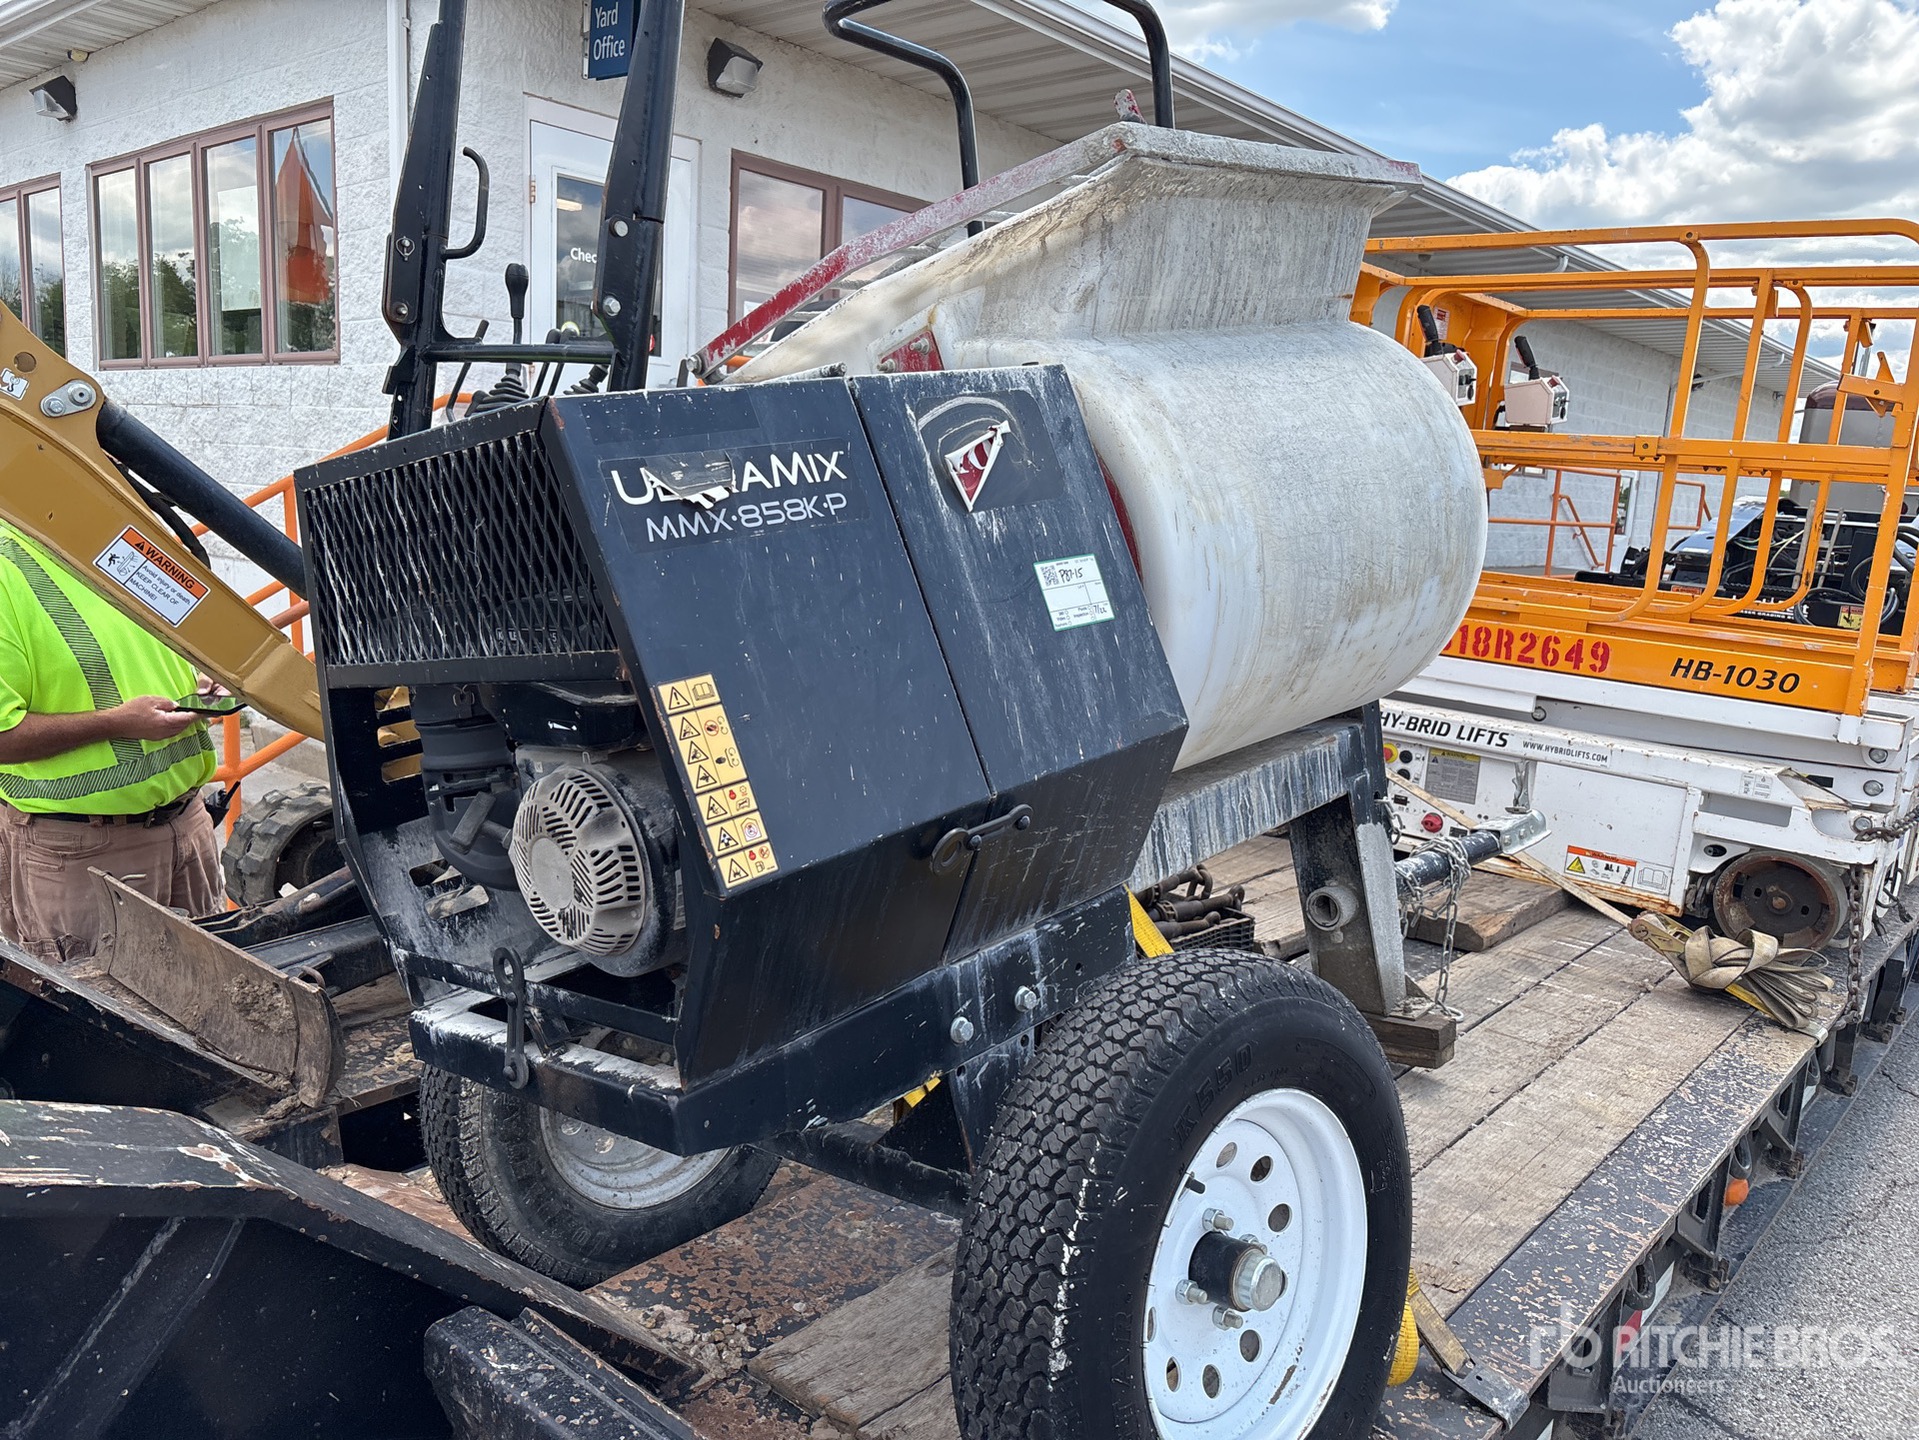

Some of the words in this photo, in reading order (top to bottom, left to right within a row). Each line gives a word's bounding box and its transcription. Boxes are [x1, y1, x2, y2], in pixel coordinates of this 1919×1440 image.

[595, 2, 619, 29] Yard
[593, 35, 625, 60] Office
[570, 247, 598, 263] Chec
[142, 565, 158, 579] Avoid
[157, 575, 171, 589] injury
[146, 547, 195, 589] WARNING
[136, 571, 153, 585] KEEP
[151, 583, 171, 600] CLEAR
[169, 597, 180, 606] OF
[1443, 624, 1612, 674] 18R2649
[1670, 656, 1801, 694] HB-1030
[1380, 711, 1451, 738] HY-BRID
[1456, 724, 1510, 748] LIFTS
[1522, 740, 1609, 763] WWW.HYBRIDLIFTS.COM
